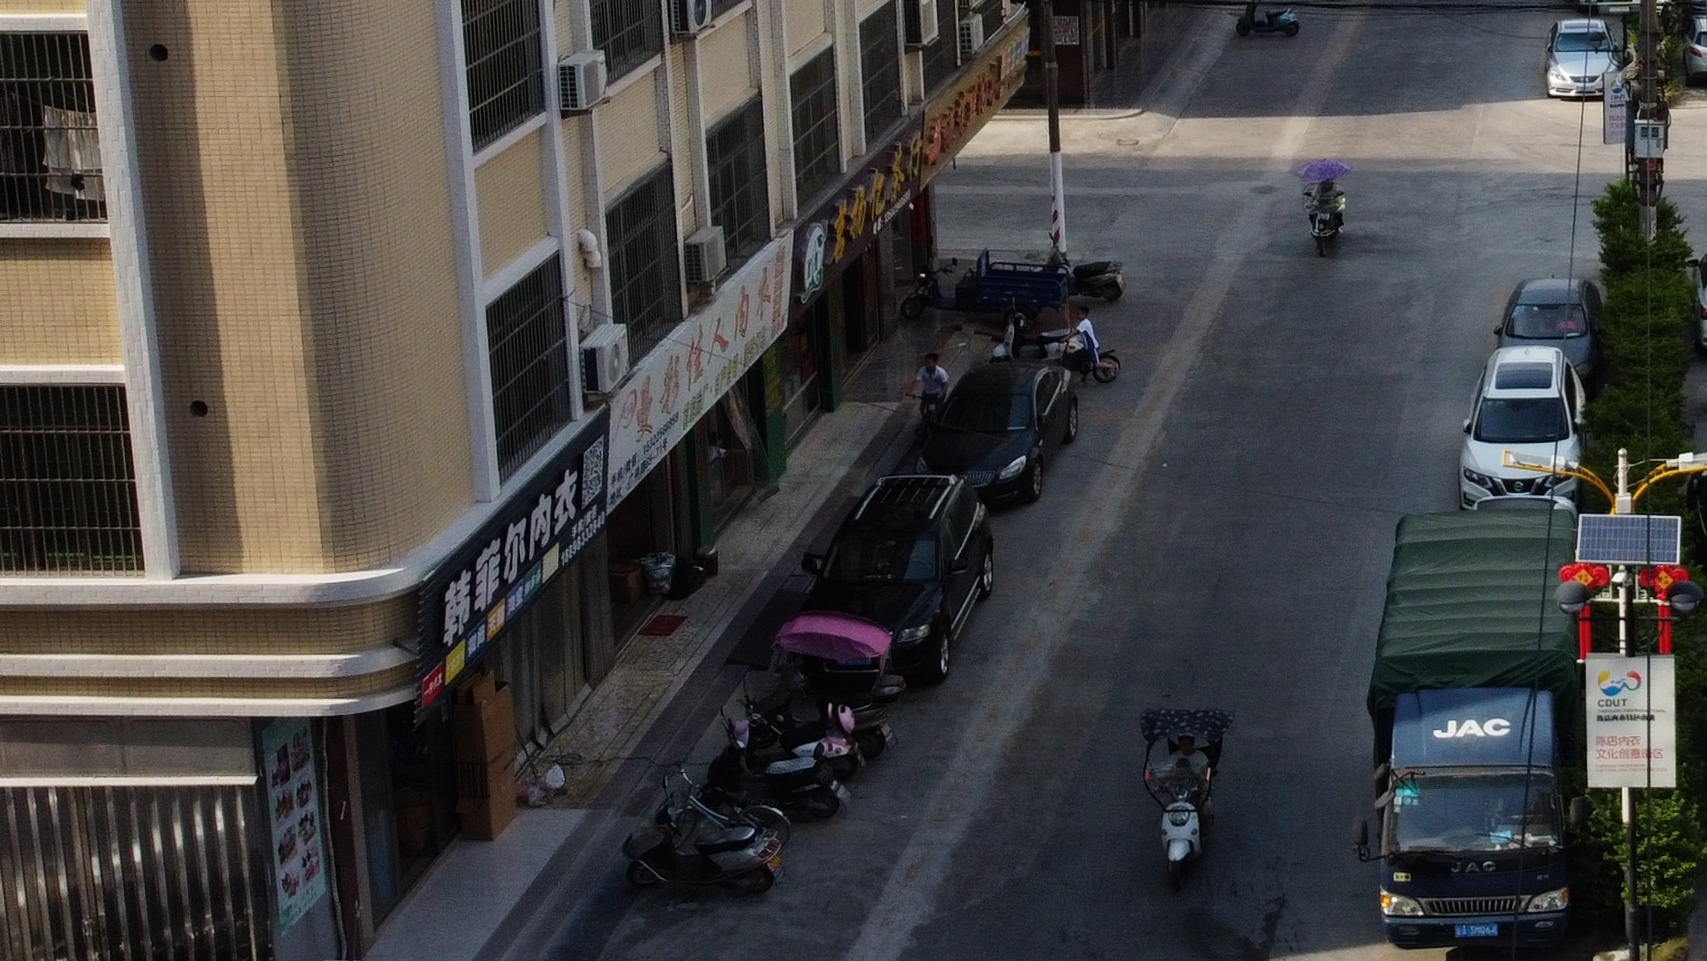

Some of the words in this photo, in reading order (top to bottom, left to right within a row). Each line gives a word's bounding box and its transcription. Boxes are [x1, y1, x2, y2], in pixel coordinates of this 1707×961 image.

[443, 468, 578, 647] 韩菲尔内衣
[1597, 698, 1628, 708] CDUT
[1432, 717, 1511, 738] JAC
[1595, 735, 1641, 746] 陈店内衣
[1450, 860, 1497, 874] JAC
